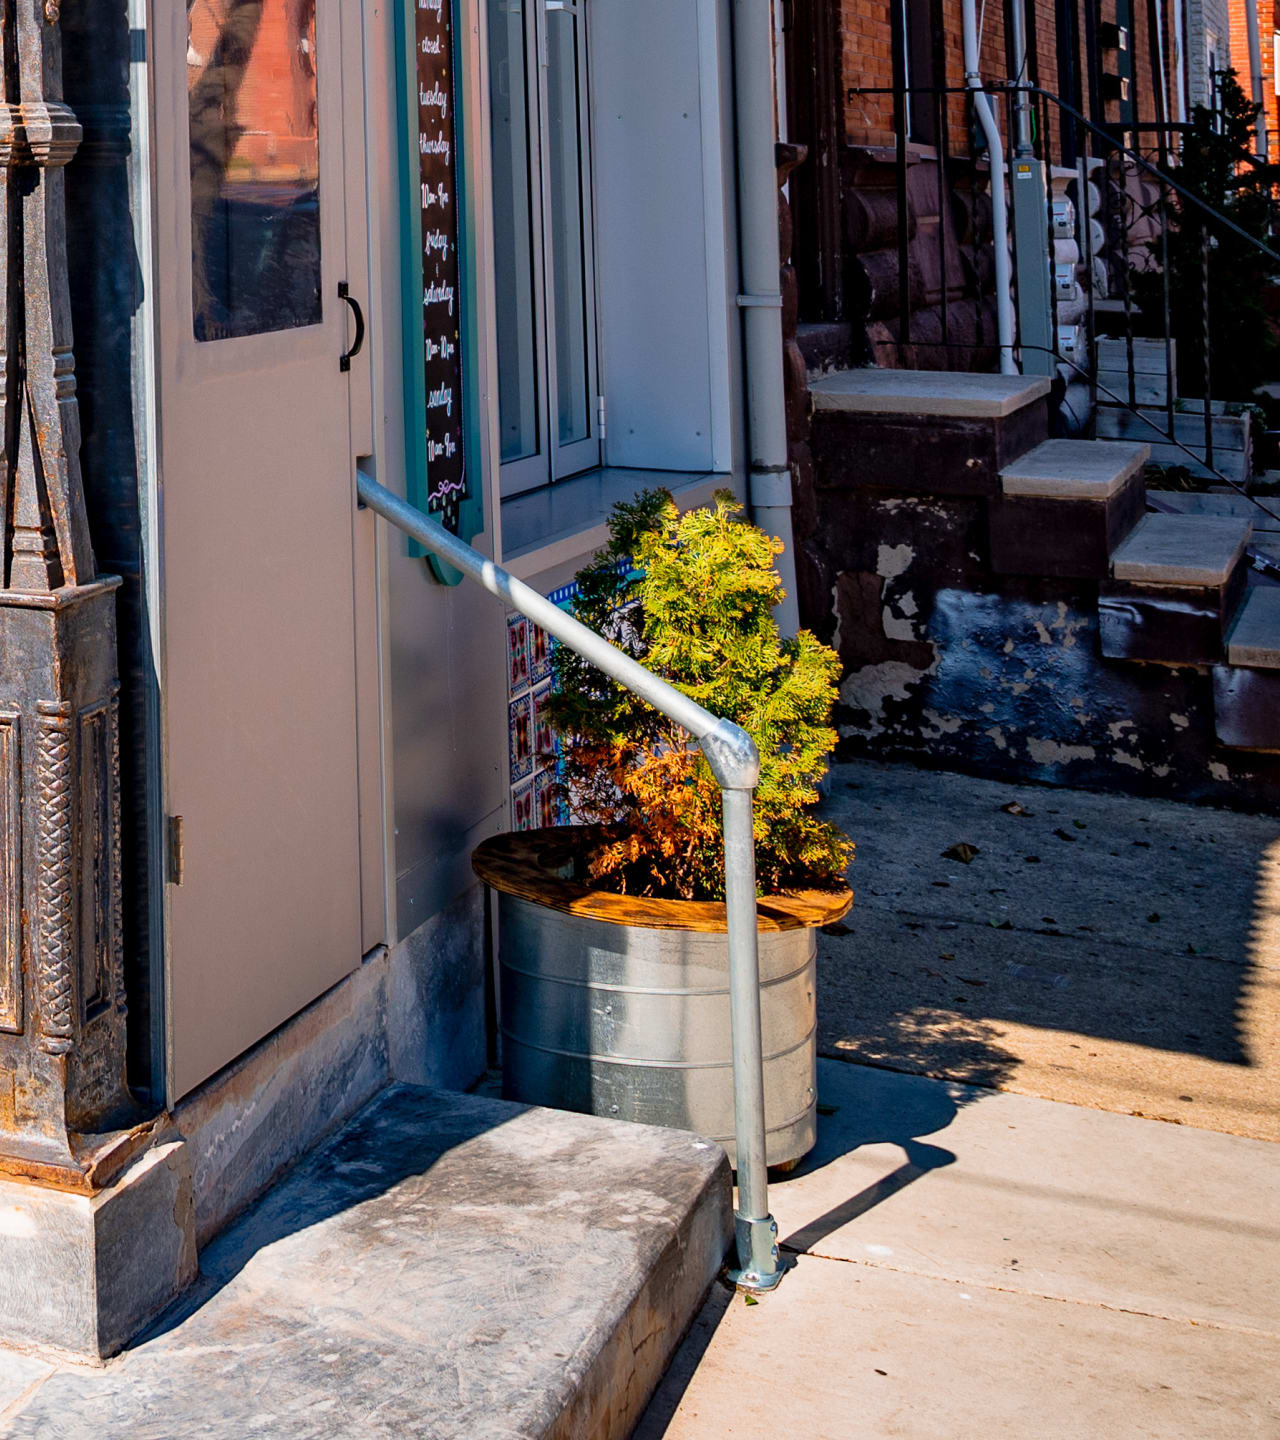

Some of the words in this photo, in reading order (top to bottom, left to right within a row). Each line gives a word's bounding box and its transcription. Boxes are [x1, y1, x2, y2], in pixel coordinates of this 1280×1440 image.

[418, 81, 448, 119] tuesday
[419, 130, 450, 166] thursday
[424, 228, 449, 261] friday
[422, 280, 454, 316] saturday
[427, 381, 453, 417] sunday
